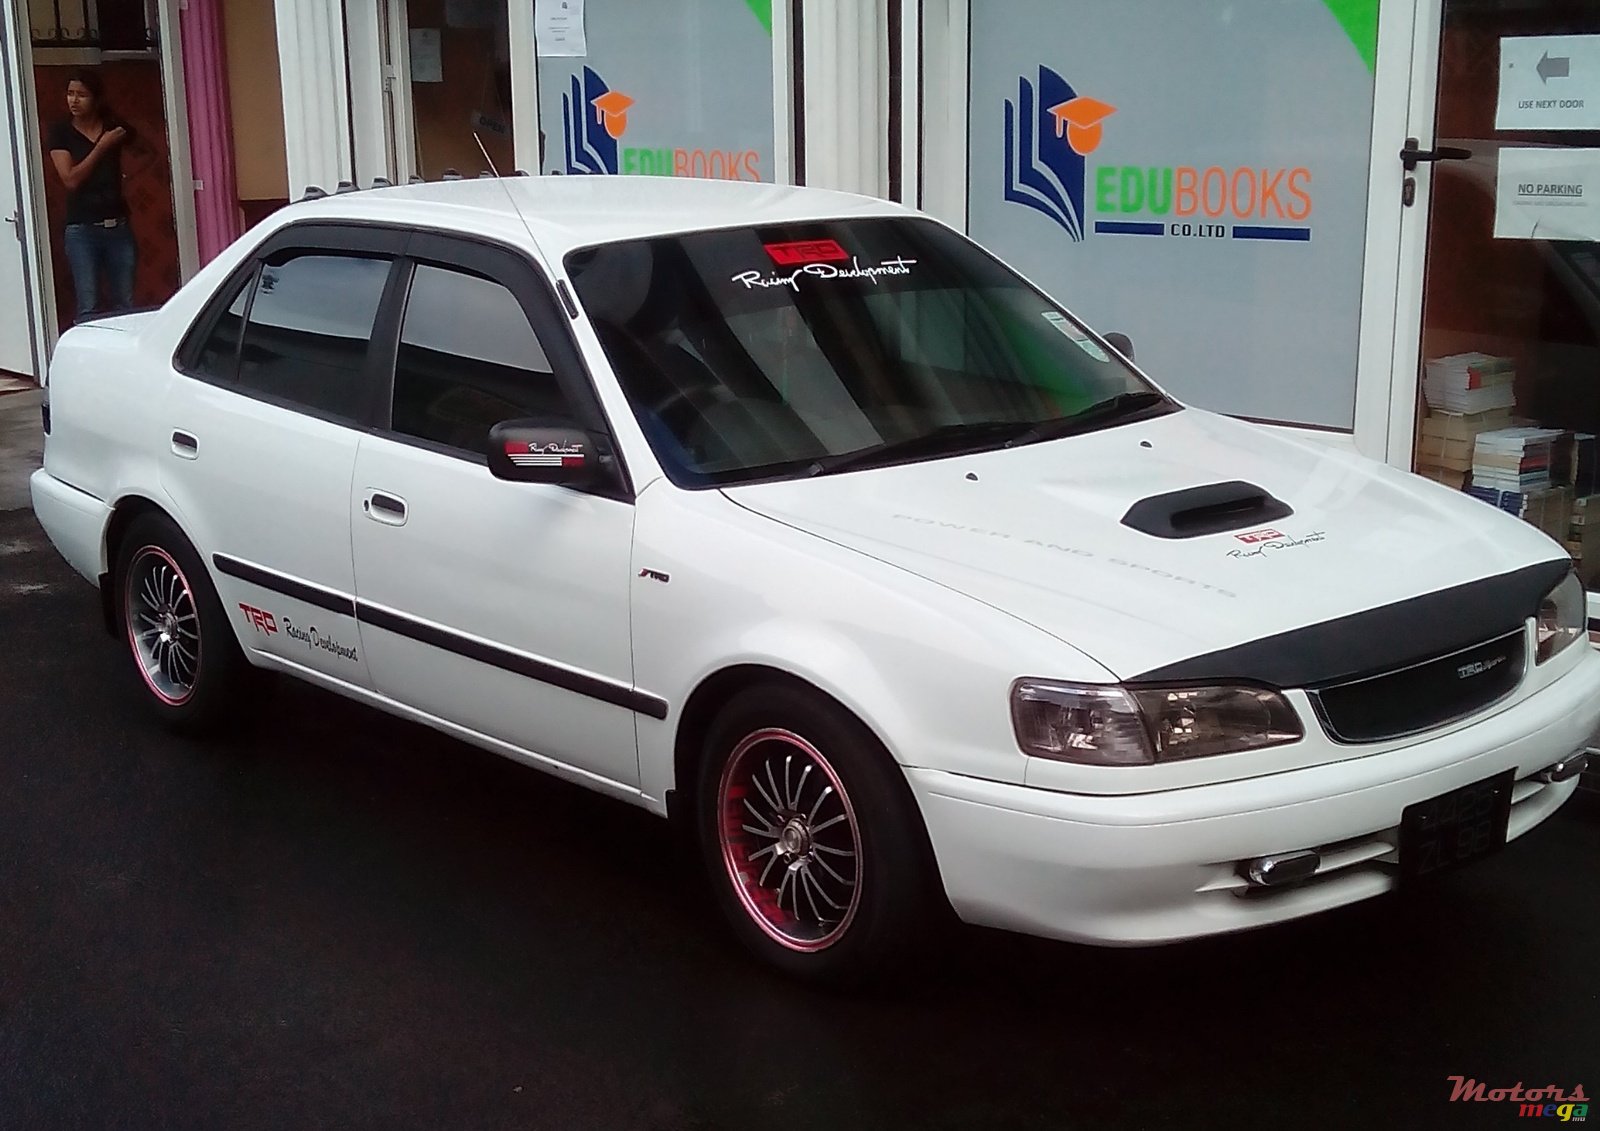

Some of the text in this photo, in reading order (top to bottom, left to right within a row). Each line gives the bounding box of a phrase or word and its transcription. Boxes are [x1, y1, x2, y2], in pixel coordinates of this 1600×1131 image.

[1518, 99, 1585, 109] USE NEXT DOOR
[623, 148, 760, 182] EDUBOOKS
[1096, 166, 1312, 220] EDUBOOKS
[1518, 184, 1583, 195] NO PARKING
[1170, 223, 1226, 239] CO.LTD
[1023, 539, 1094, 557] AND
[1108, 557, 1237, 598] SPORTS
[238, 602, 278, 636] TRD
